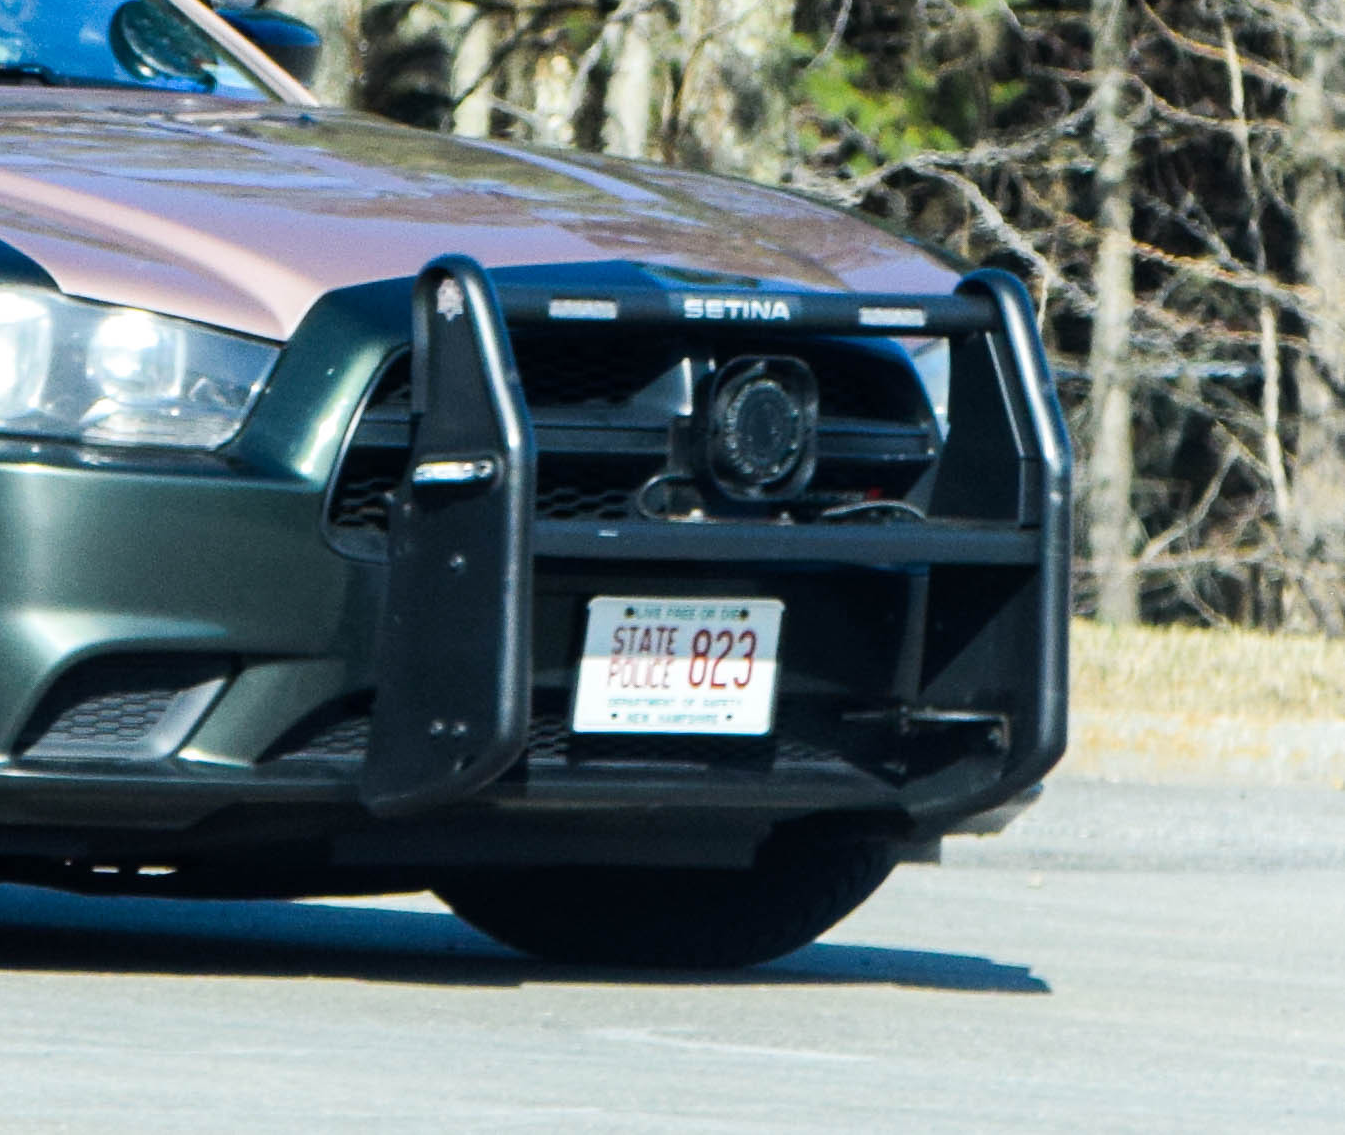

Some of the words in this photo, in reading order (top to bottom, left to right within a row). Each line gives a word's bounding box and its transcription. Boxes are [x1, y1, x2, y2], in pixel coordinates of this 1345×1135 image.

[684, 298, 791, 321] SETINA
[610, 625, 679, 655] STATE
[607, 657, 675, 690] POLICE
[688, 628, 757, 690] 823
